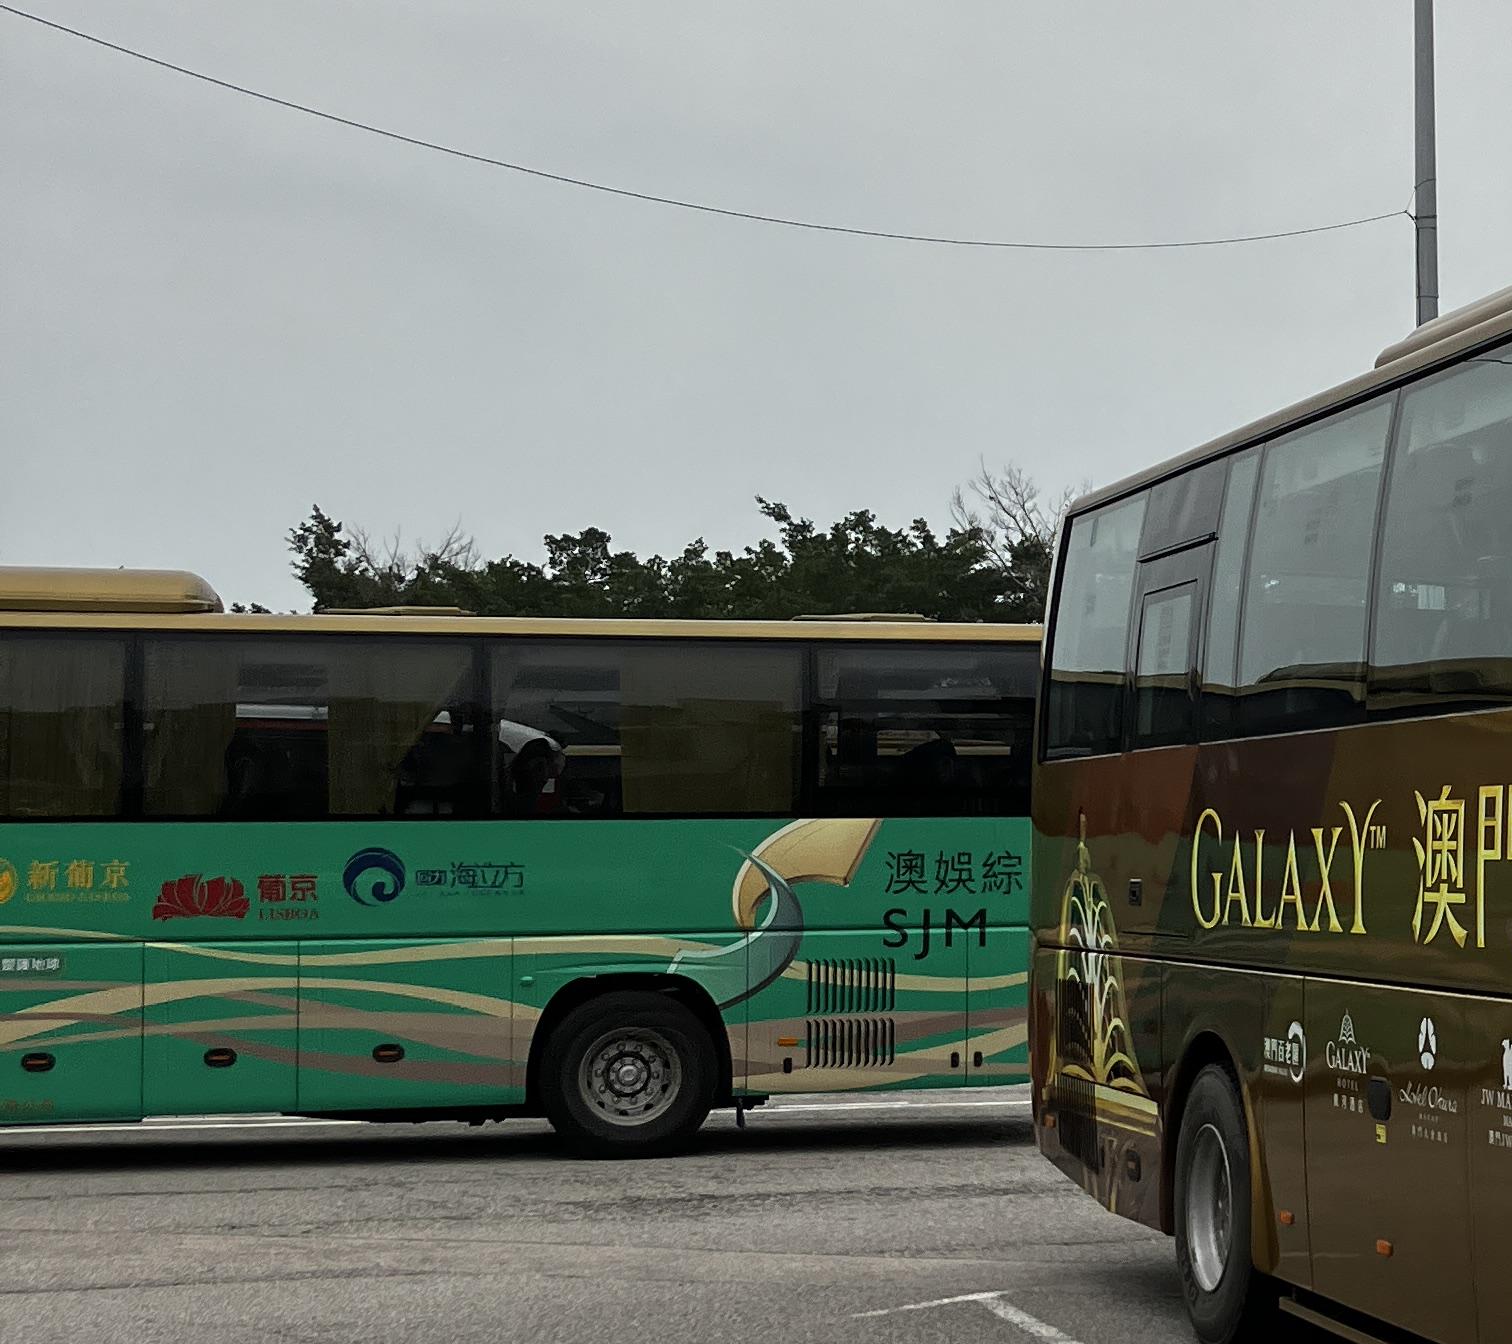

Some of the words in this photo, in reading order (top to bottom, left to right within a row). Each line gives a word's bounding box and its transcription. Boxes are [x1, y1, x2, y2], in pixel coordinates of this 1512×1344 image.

[27, 859, 130, 890] 新葡京
[257, 873, 319, 903] 葡京
[882, 907, 987, 961] SJM
[1480, 1088, 1496, 1106] JW
